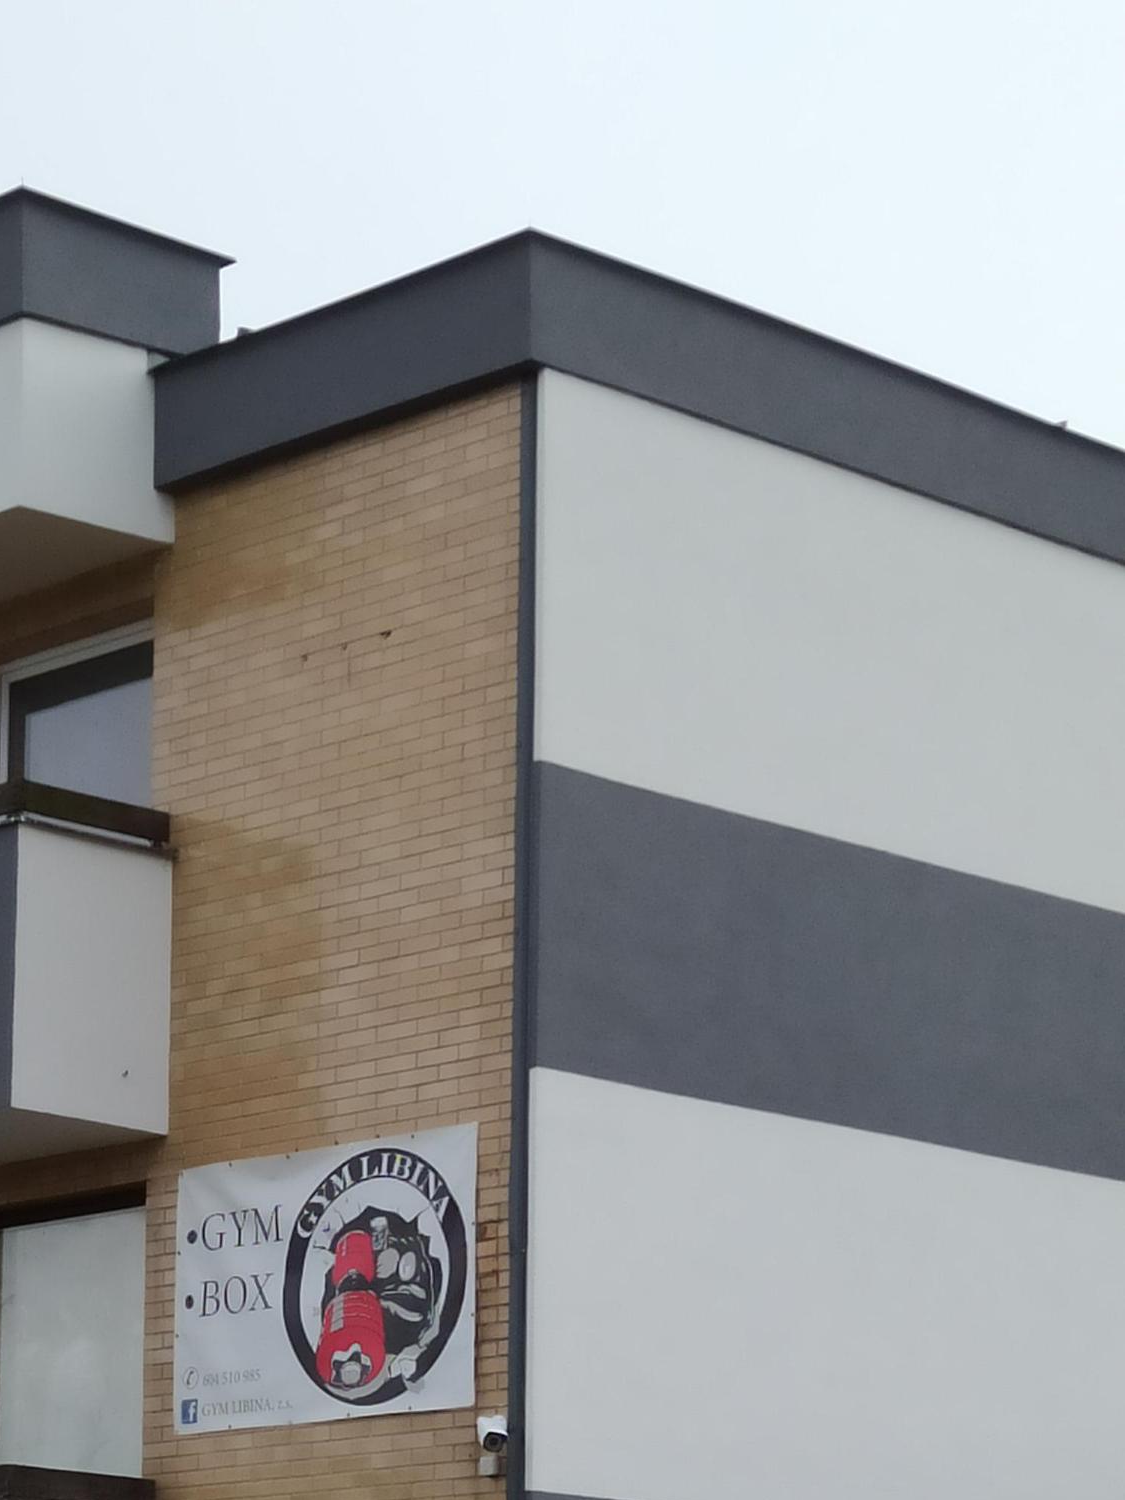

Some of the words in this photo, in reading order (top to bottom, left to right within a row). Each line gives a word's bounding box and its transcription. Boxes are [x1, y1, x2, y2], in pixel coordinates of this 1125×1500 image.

[297, 1163, 355, 1239] GYM
[360, 1152, 450, 1224] LIBINA
[201, 1204, 283, 1251] GYM
[198, 1273, 274, 1318] BOX
[201, 1401, 229, 1417] GYM
